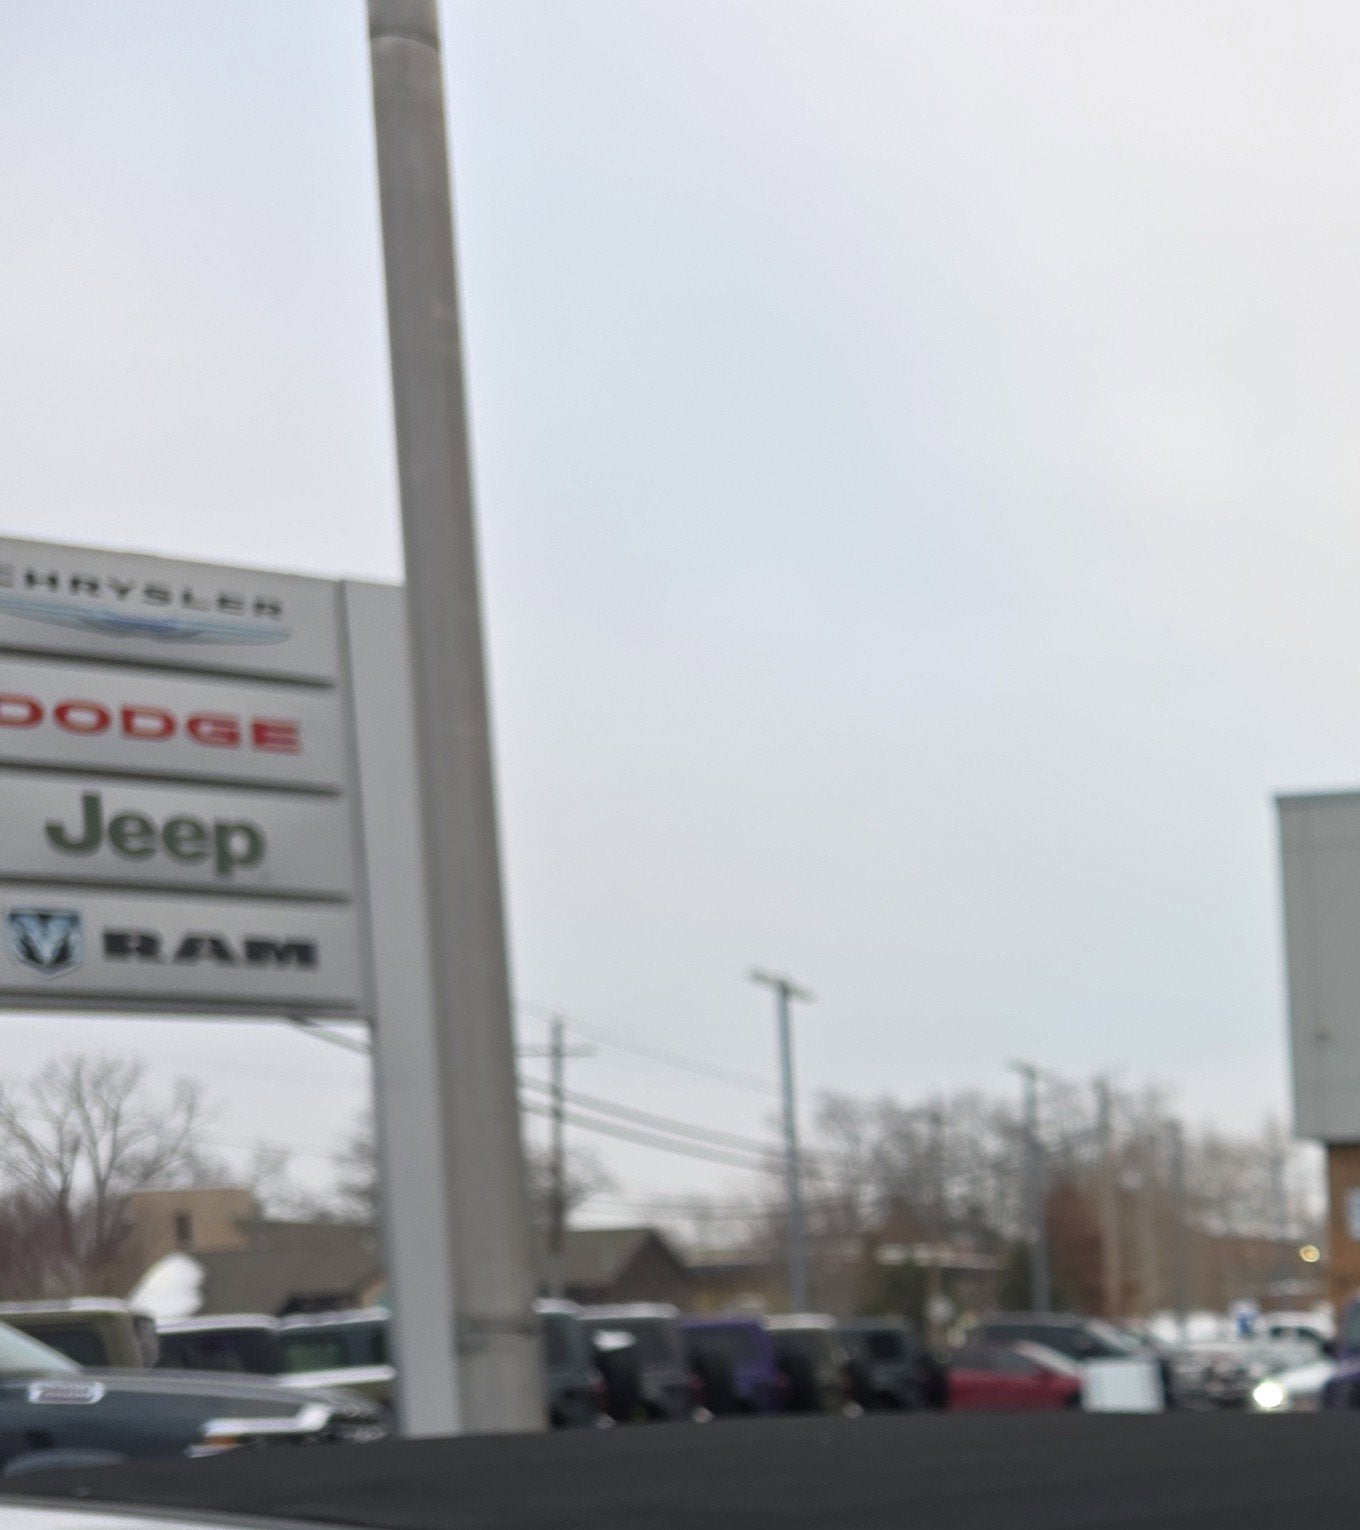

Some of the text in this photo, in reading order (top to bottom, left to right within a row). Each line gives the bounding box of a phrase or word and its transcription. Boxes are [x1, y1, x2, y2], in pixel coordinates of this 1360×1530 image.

[0, 693, 302, 754] DODGE
[45, 791, 268, 877] Jeep
[102, 926, 320, 971] RAM
